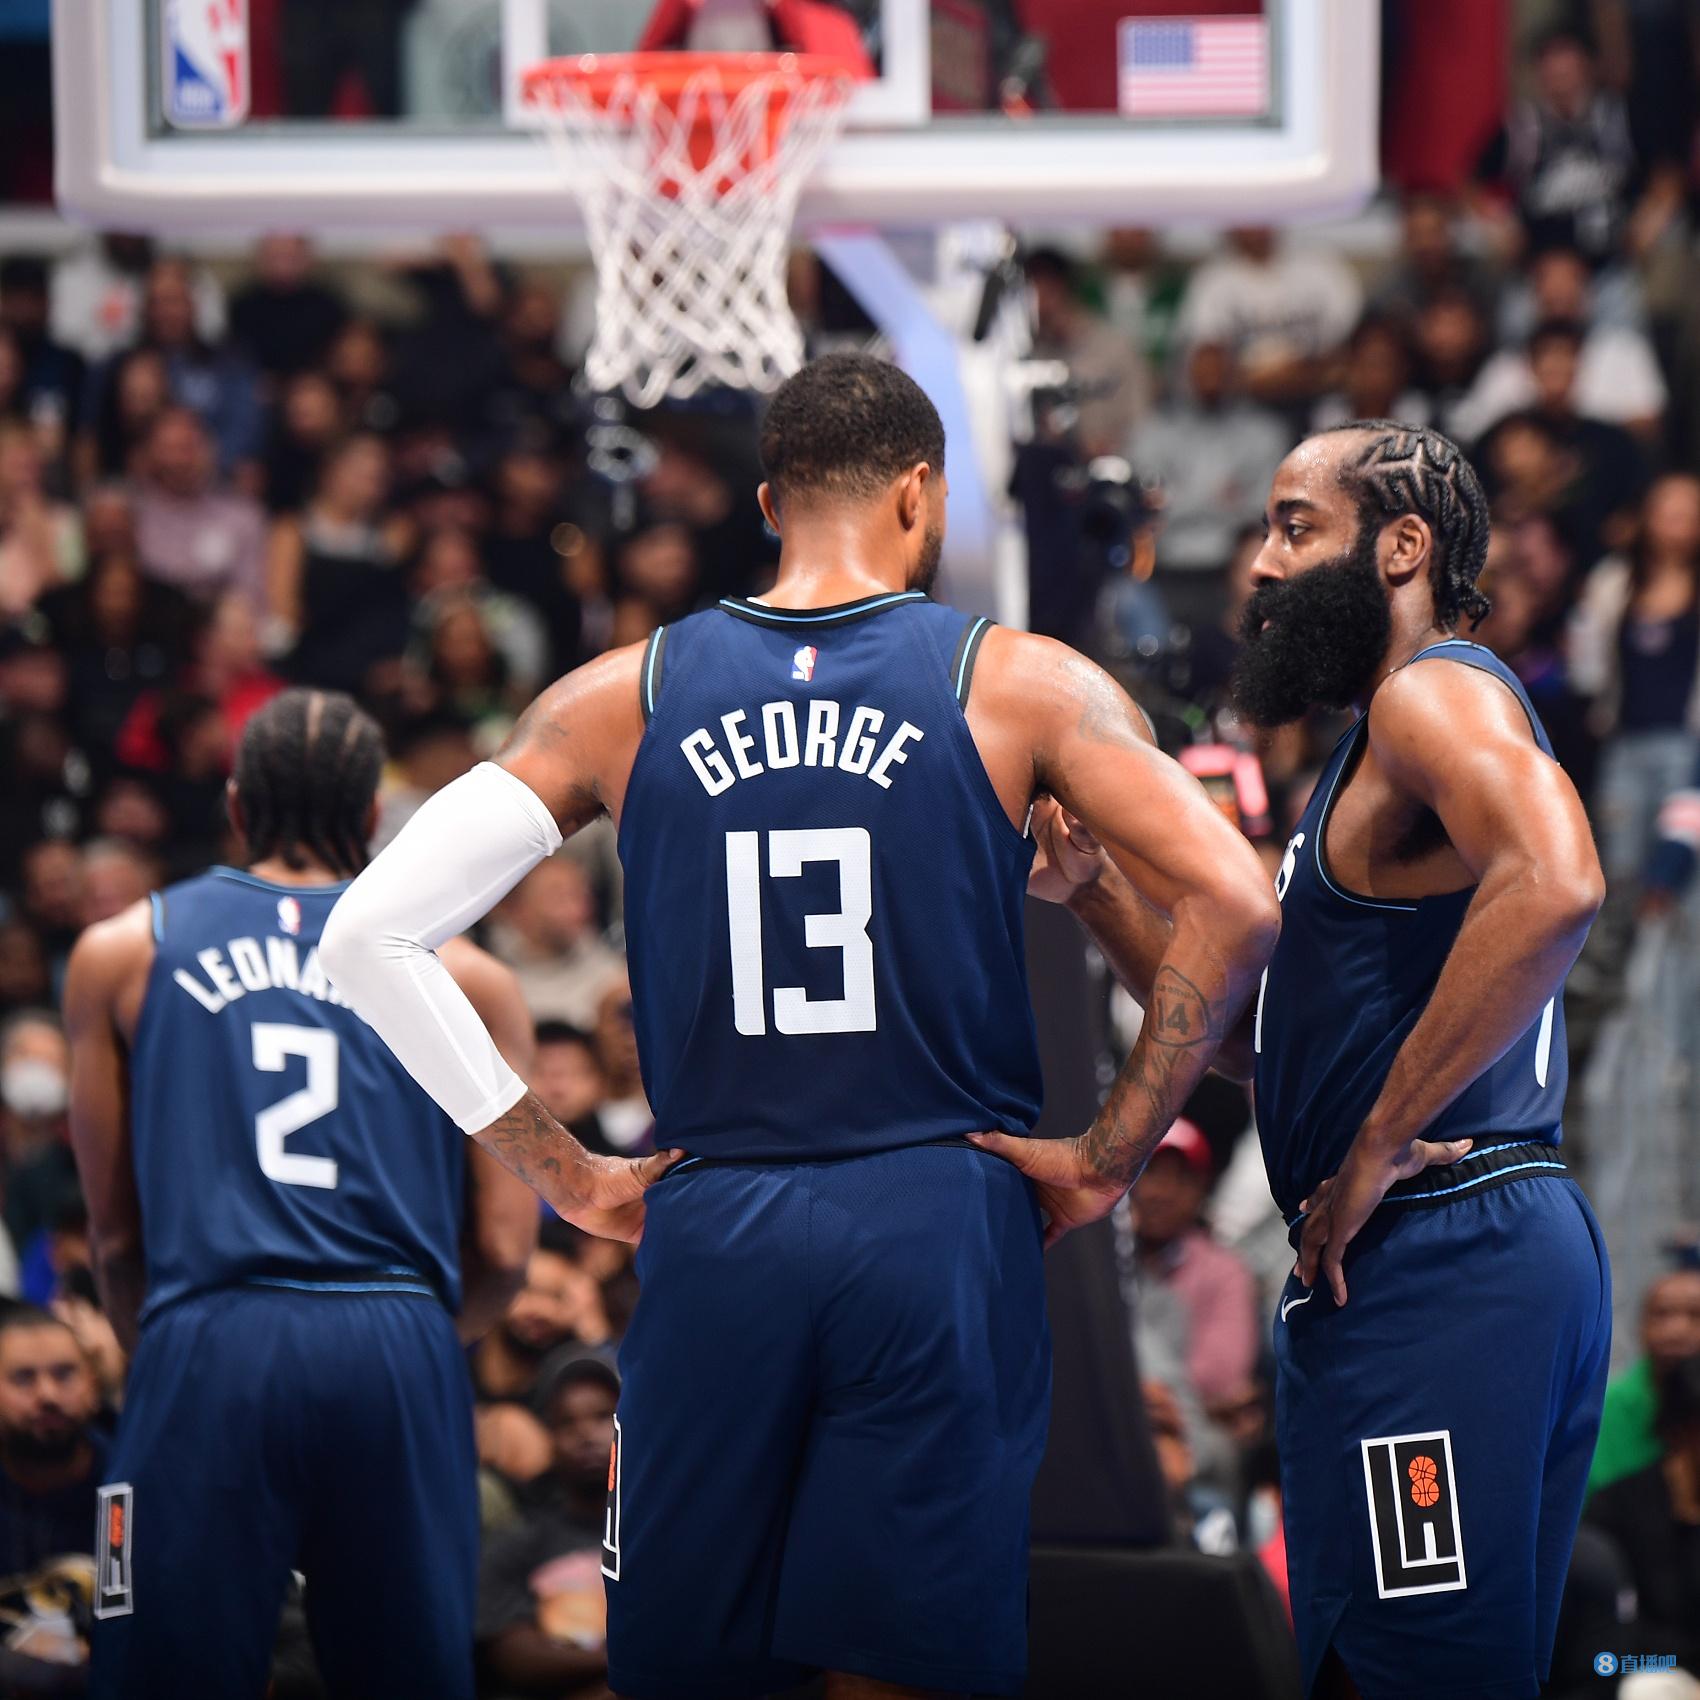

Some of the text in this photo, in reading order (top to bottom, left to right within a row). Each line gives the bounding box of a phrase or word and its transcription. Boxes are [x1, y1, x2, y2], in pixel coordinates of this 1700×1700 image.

[680, 699, 924, 797] GEORGE
[173, 935, 356, 1015] LEONA
[725, 827, 877, 1036] 13
[1157, 997, 1191, 1036] 14
[251, 1022, 339, 1190] 2
